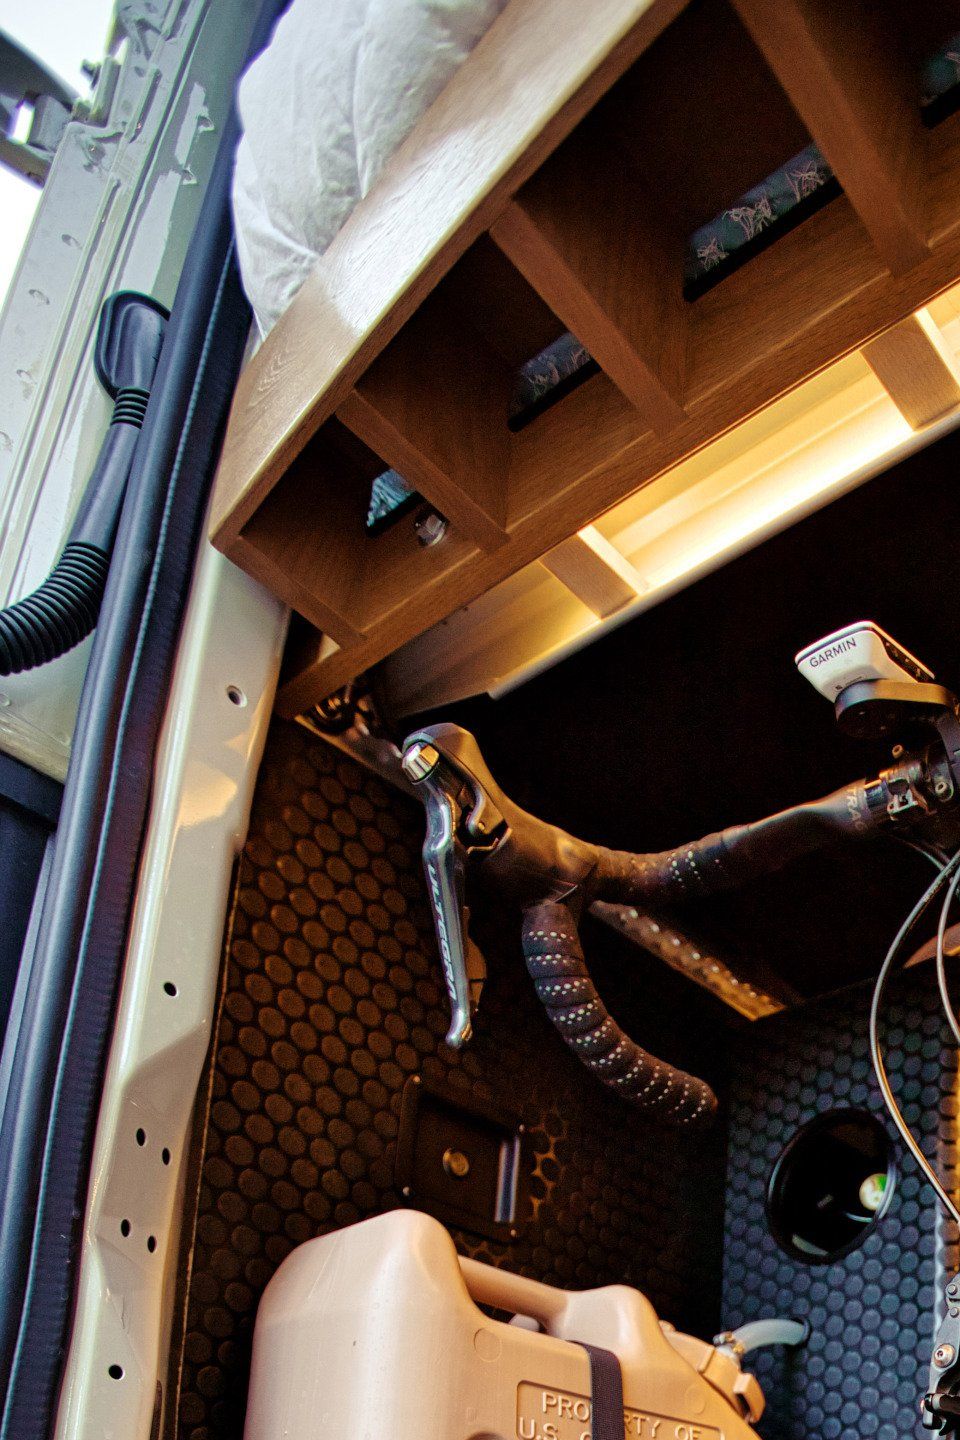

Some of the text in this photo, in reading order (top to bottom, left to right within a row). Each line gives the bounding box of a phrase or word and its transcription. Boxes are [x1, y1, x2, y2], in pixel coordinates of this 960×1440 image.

[809, 637, 857, 667] GARMIN
[427, 864, 457, 1001] ULTEGRA
[542, 1391, 661, 1439] PRORTY
